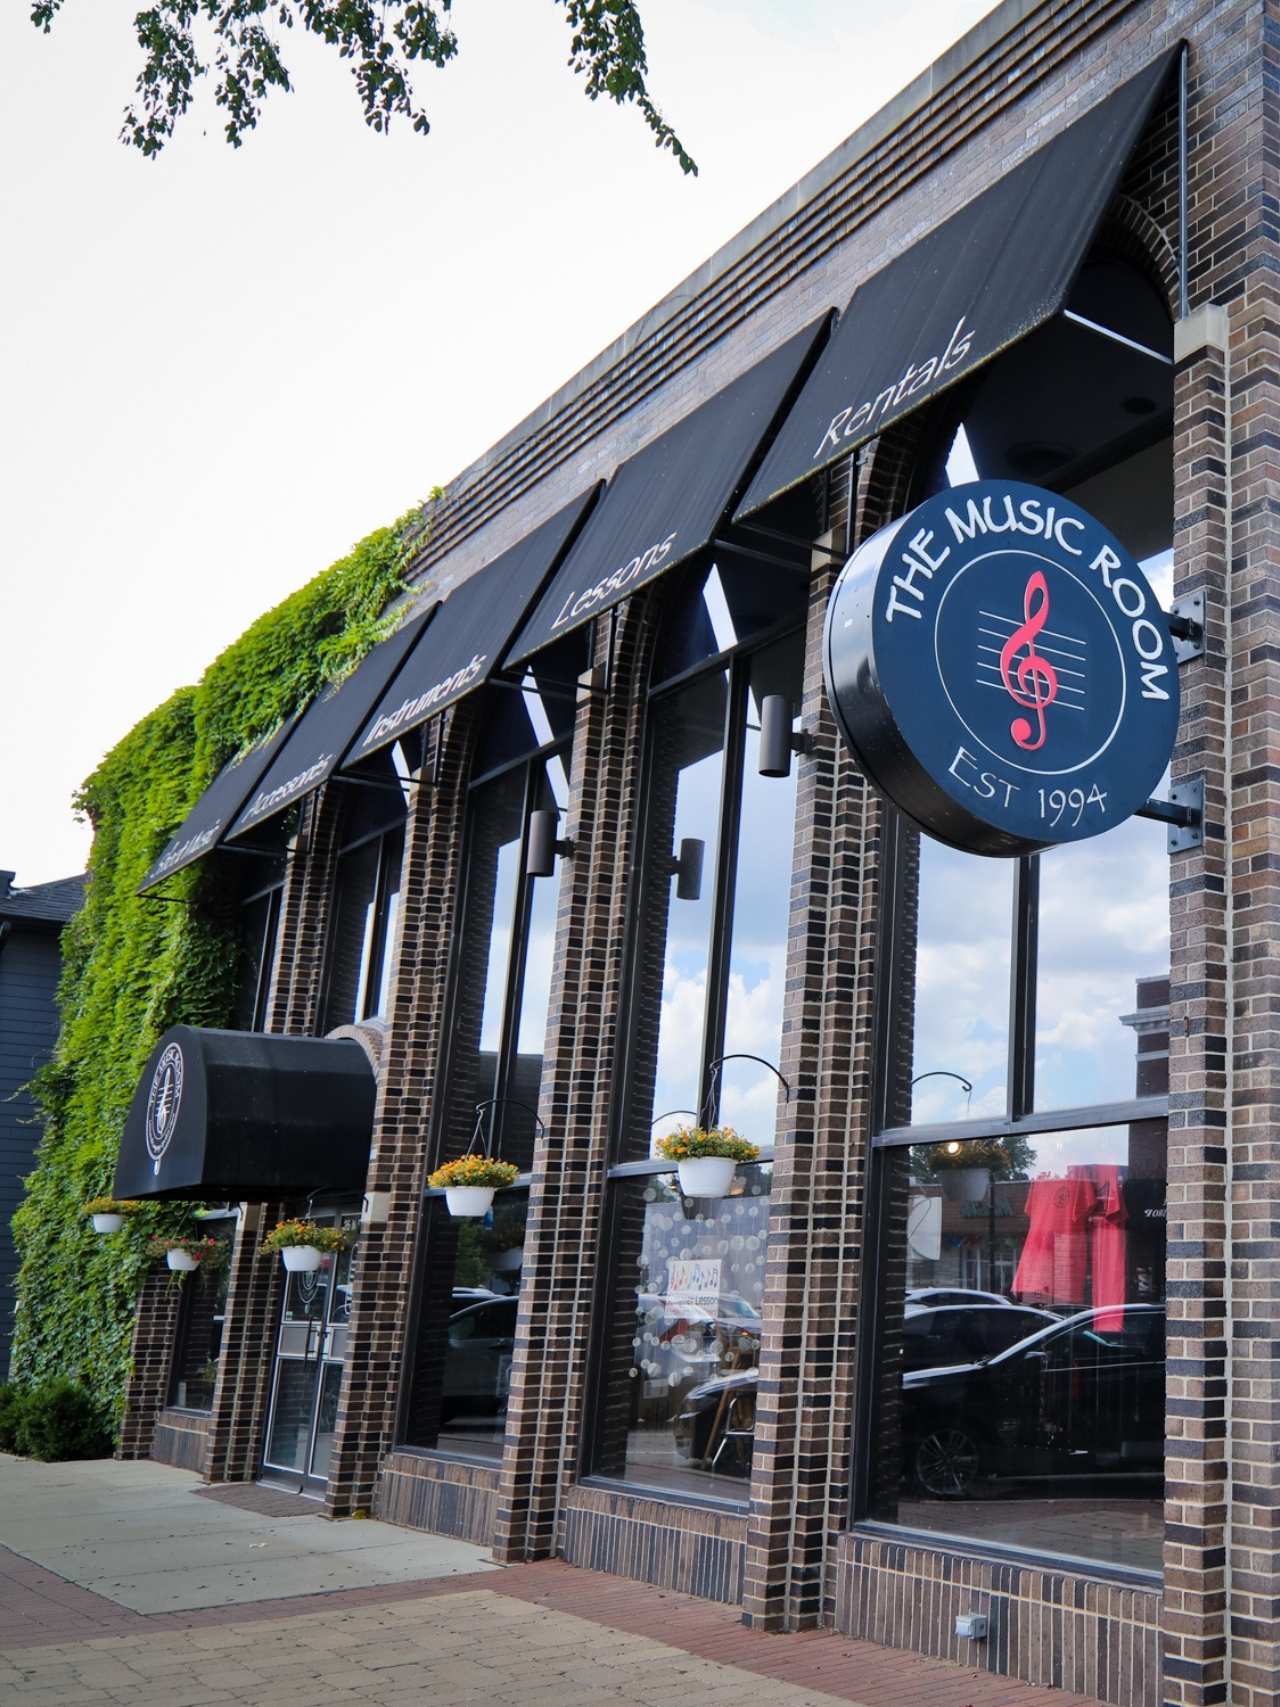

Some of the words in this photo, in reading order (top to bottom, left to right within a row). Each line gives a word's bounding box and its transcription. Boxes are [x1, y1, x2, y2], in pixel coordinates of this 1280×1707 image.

[813, 315, 976, 459] Rentals
[550, 531, 678, 630] Lessons
[885, 528, 951, 623] THE
[944, 494, 1086, 556] MUSIC
[1089, 544, 1171, 701] ROOM
[362, 653, 488, 747] Instruments
[947, 746, 1020, 808] EST
[1038, 784, 1108, 828] 1994
